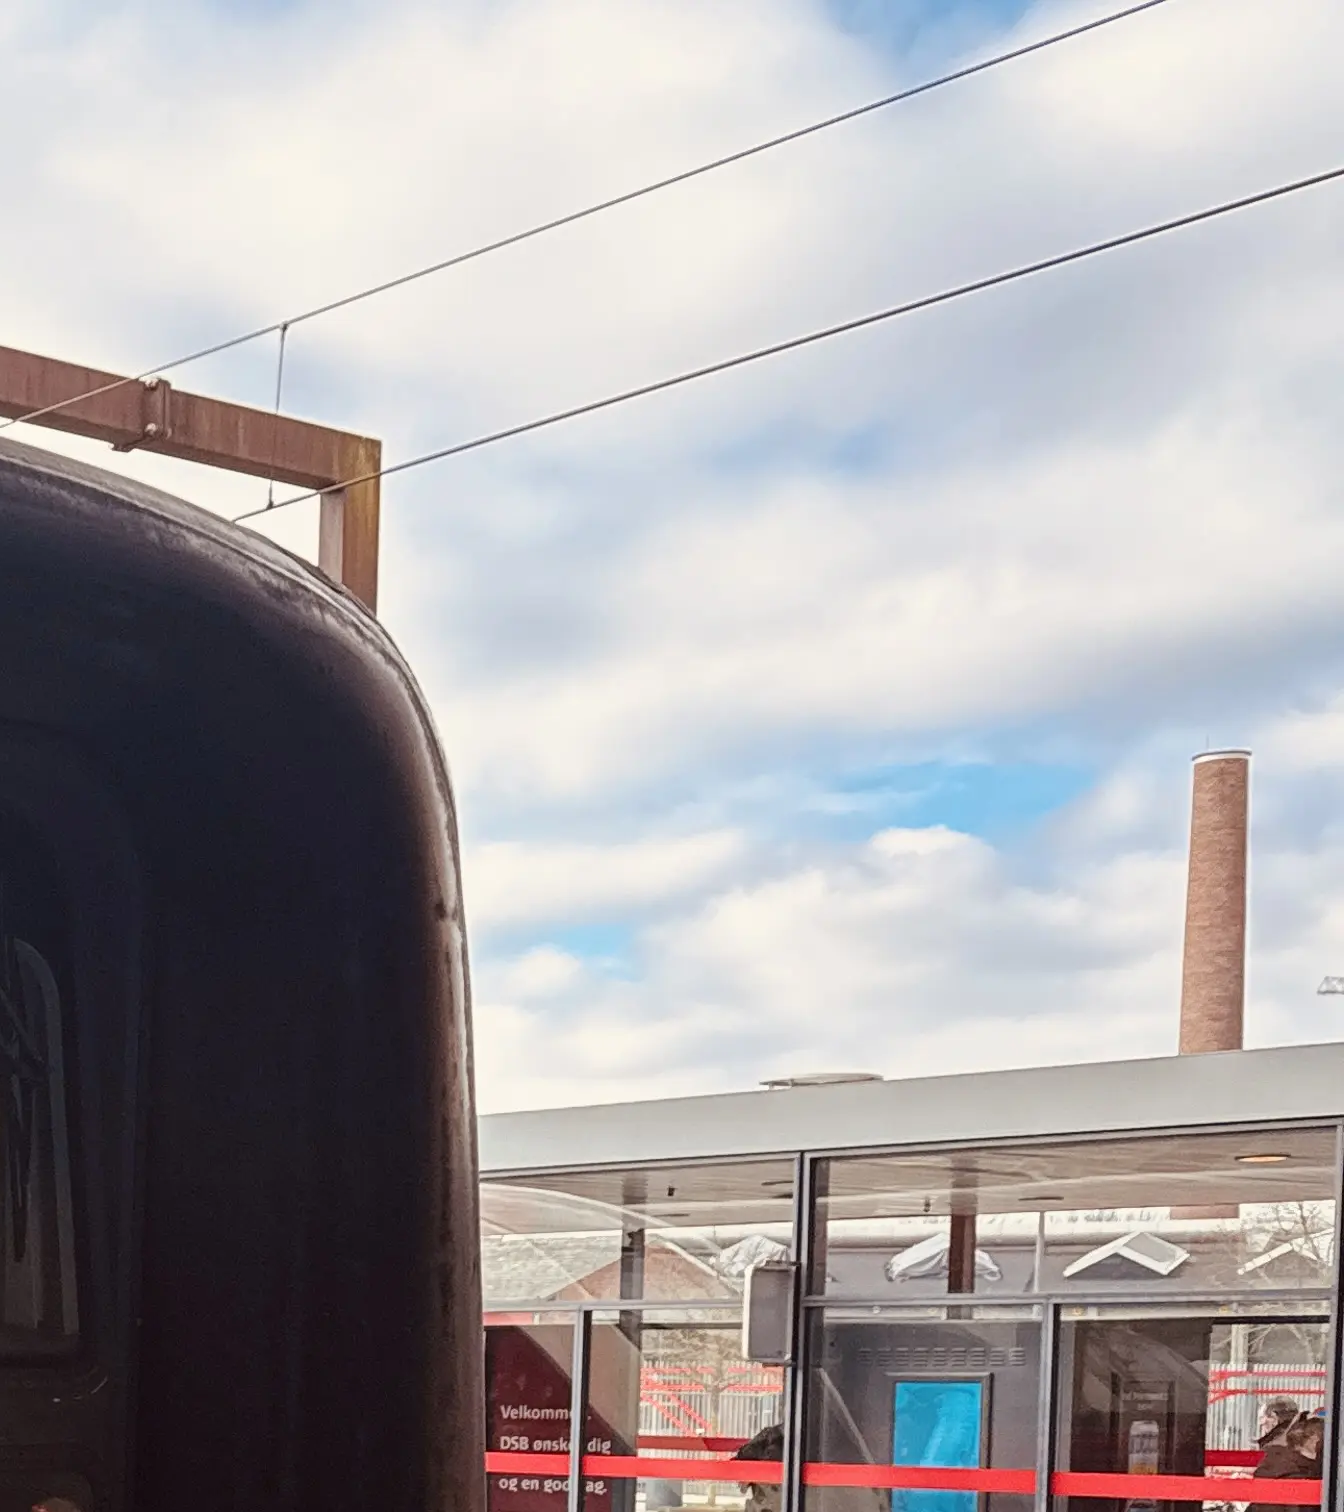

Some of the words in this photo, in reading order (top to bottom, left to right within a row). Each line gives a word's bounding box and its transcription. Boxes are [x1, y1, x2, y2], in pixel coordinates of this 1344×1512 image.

[499, 1436, 529, 1451] DSB
[533, 1437, 572, 1452] ønsk
[587, 1438, 612, 1455] dig
[498, 1478, 518, 1493] og
[521, 1478, 540, 1491] en
[585, 1481, 608, 1495] ag.
